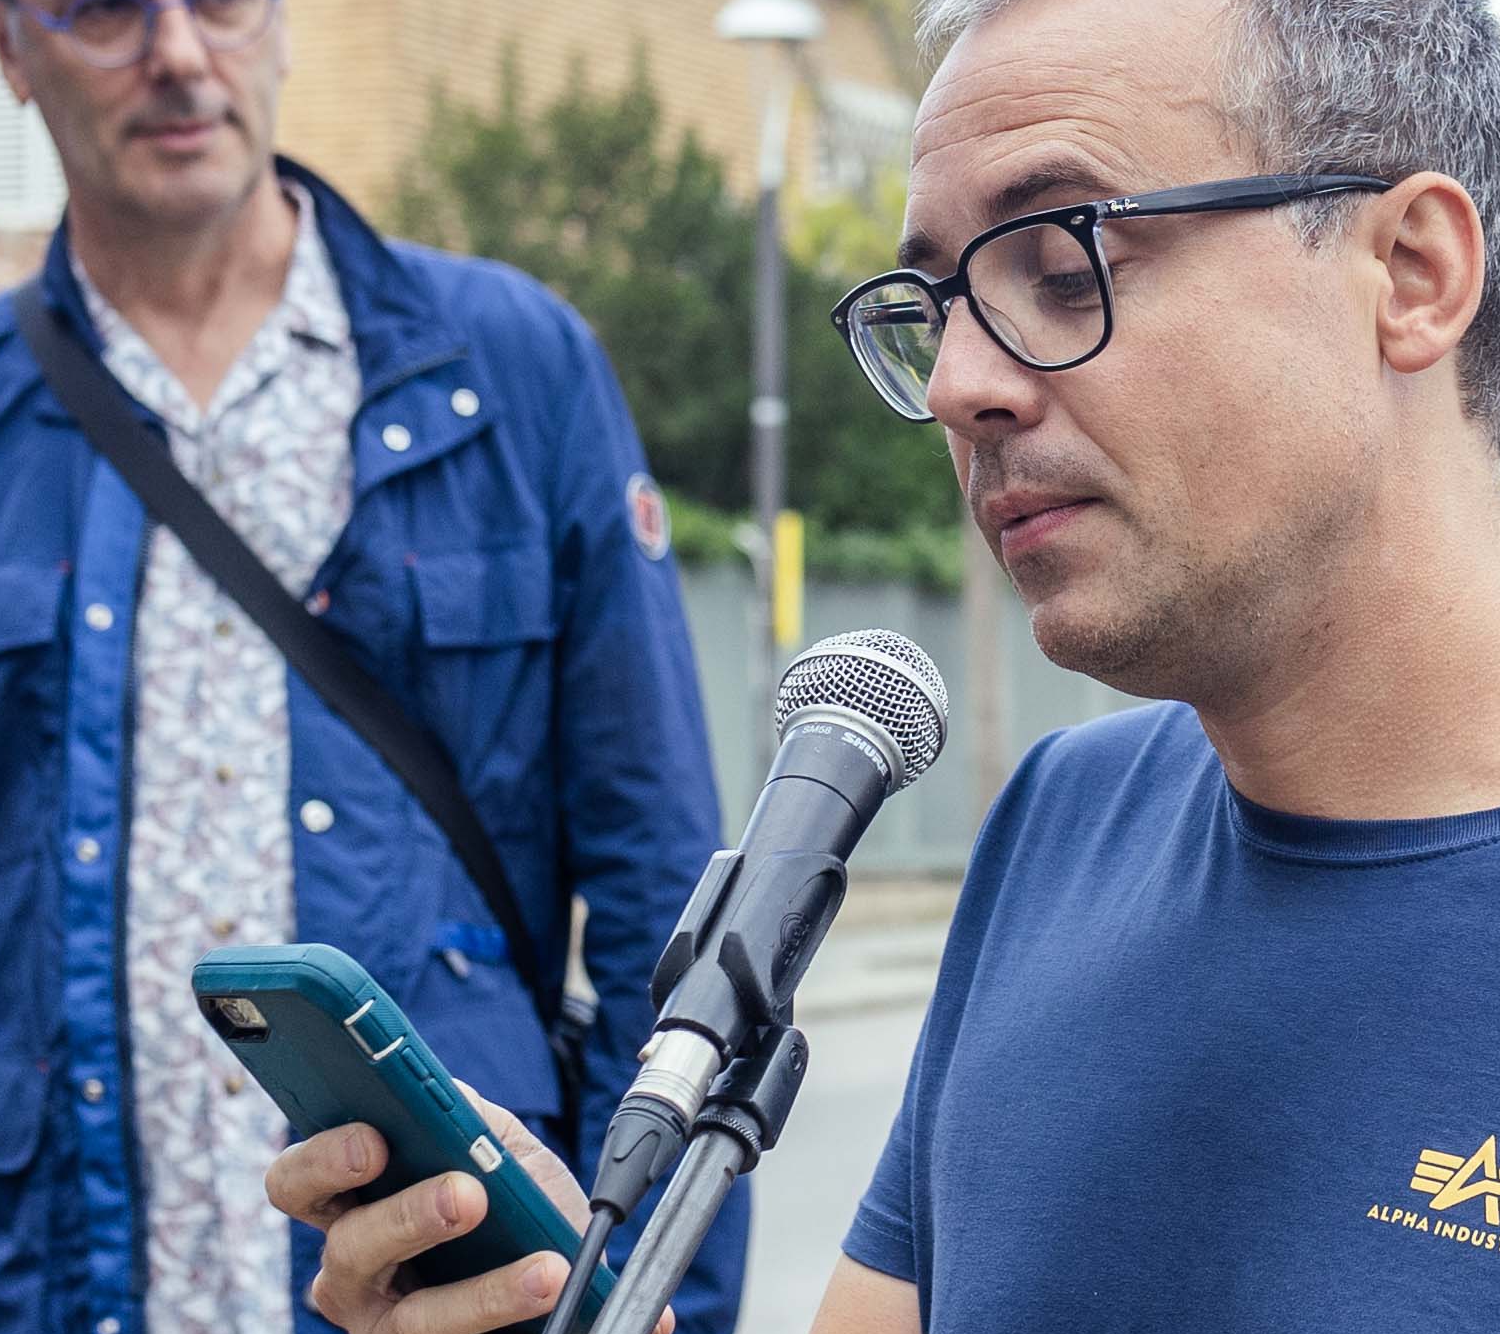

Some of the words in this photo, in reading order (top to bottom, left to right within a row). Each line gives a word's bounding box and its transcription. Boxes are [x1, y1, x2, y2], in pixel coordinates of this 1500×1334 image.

[802, 725, 832, 735] SM58
[840, 731, 889, 777] SHURE
[1366, 1204, 1429, 1232] ALPHA
